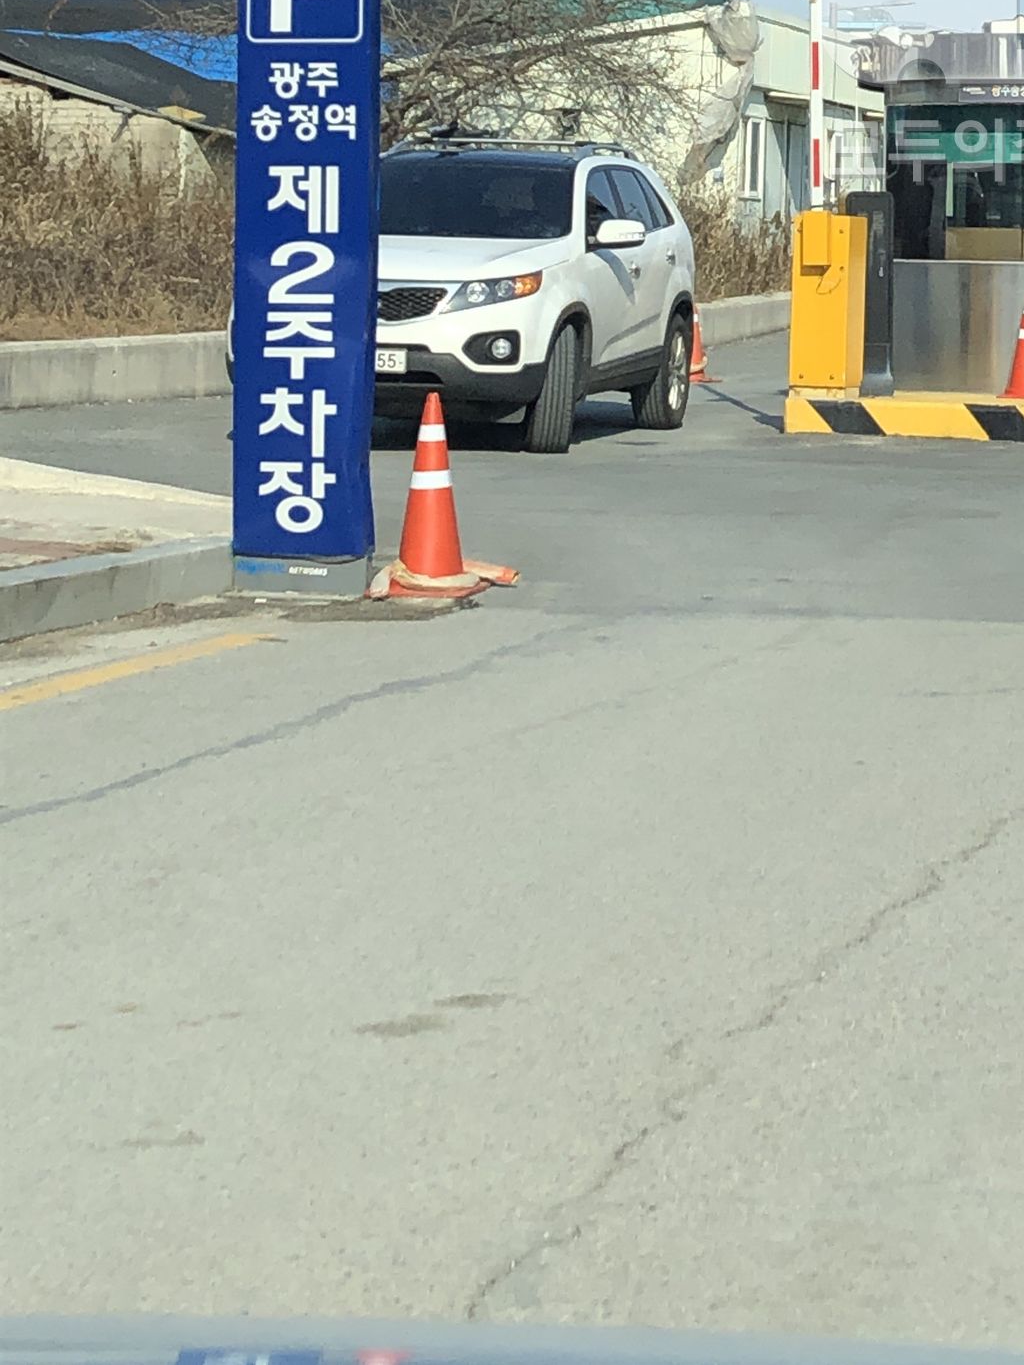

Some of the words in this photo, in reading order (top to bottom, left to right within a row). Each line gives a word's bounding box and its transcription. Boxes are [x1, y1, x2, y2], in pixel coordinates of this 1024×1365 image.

[268, 62, 338, 99] 광주
[251, 103, 356, 142] 송정역
[259, 165, 338, 532] 제2주차장
